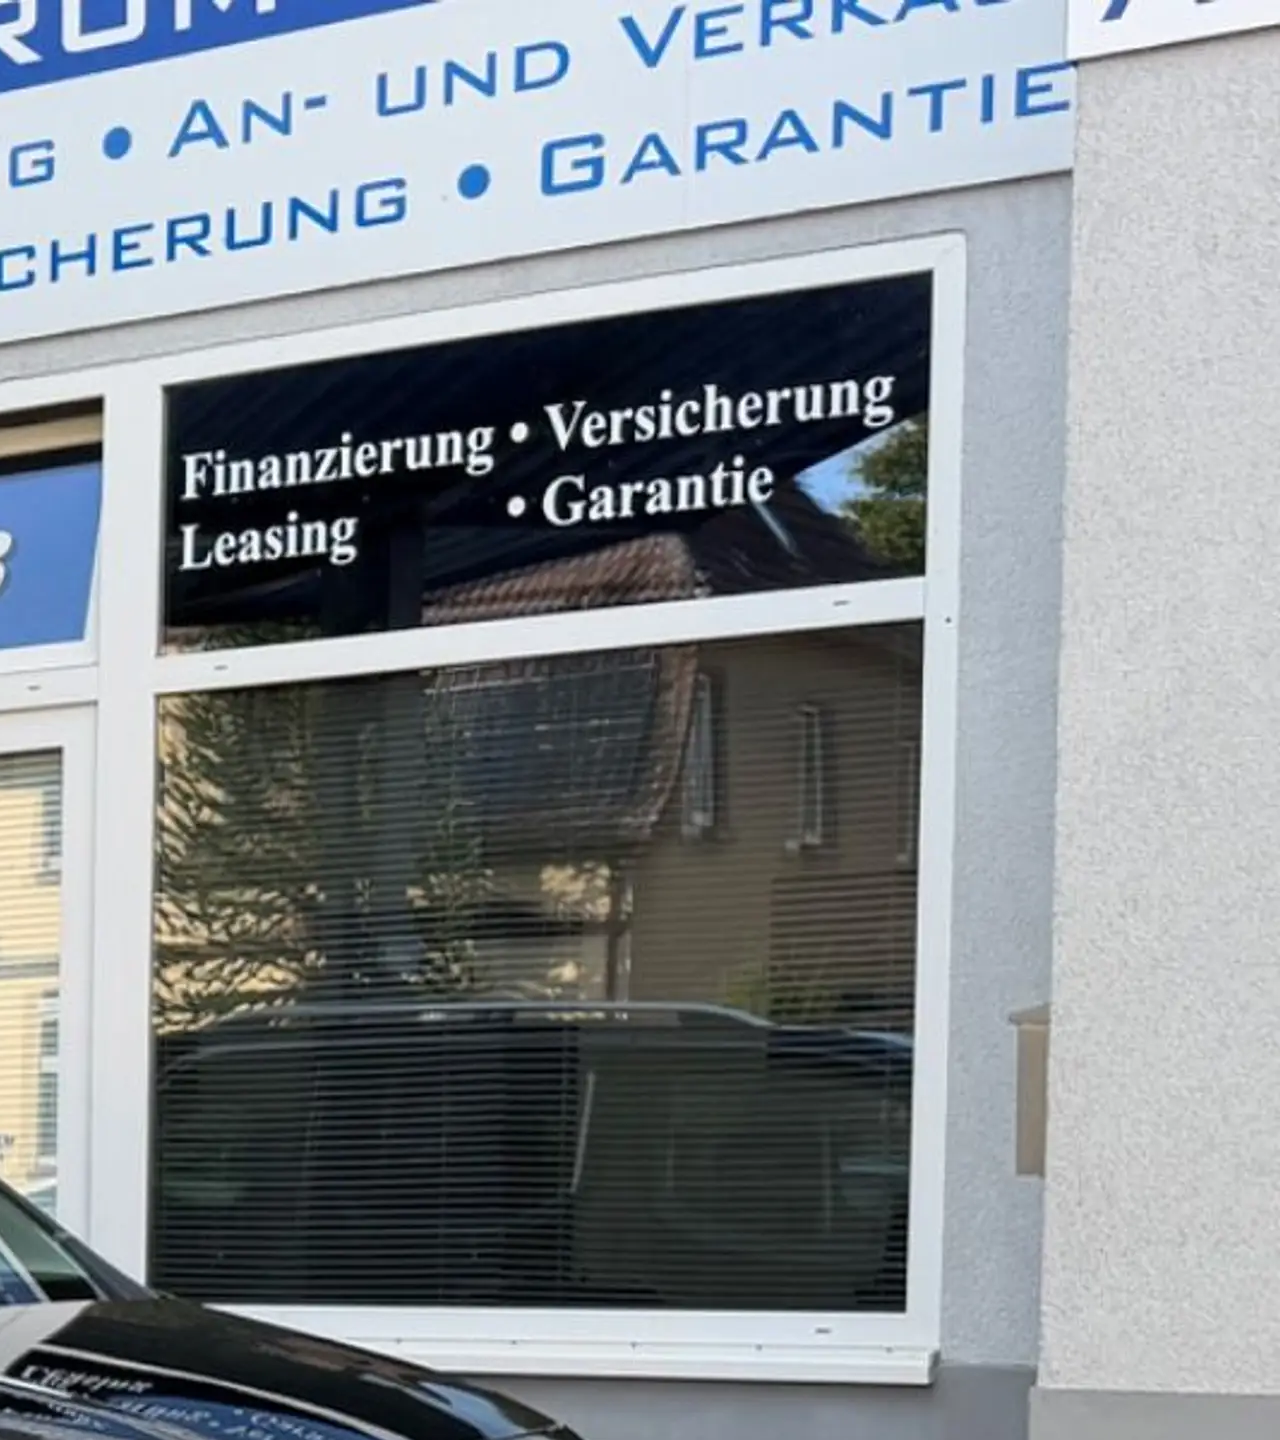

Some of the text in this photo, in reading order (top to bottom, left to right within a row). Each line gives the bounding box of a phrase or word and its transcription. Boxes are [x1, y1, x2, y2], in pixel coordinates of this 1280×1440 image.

[166, 91, 329, 158] AN-
[375, 40, 571, 117] UND
[618, 0, 1016, 69] VERK
[540, 60, 1077, 196] GARANTIE
[180, 374, 896, 500] Finanzierung Versicherung
[179, 458, 774, 571] Leasing Garantie
